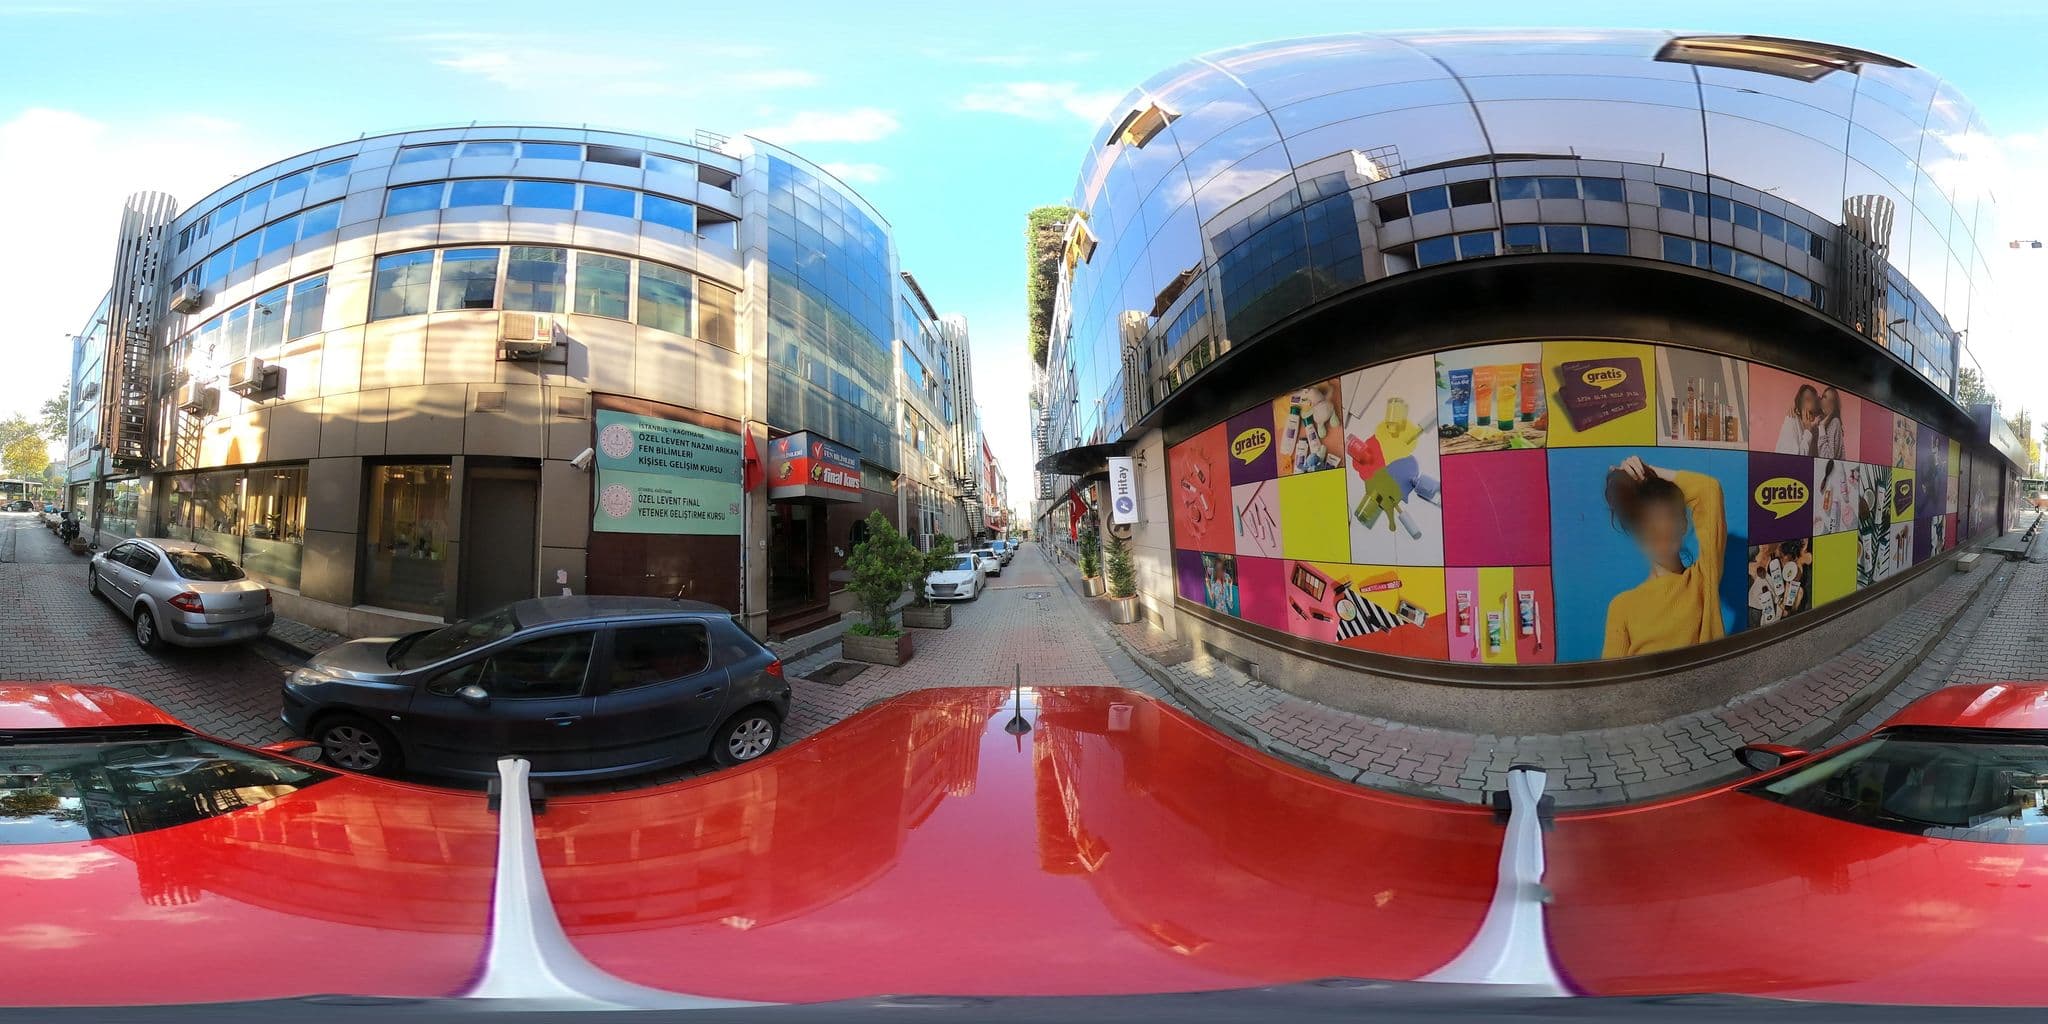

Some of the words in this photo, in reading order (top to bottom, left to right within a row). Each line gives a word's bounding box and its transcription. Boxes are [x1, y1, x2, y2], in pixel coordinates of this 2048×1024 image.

[1587, 369, 1622, 383] gratis
[638, 444, 654, 453] FEN
[656, 446, 693, 458] BİLİMLERİ
[639, 432, 659, 443] ÖZEL
[661, 437, 690, 447] LEVENT
[691, 441, 714, 452] NAZMİ
[715, 446, 739, 456] ARIKAN
[1235, 430, 1266, 456] gratis
[638, 456, 667, 467] KİŞİSEL
[669, 460, 699, 471] GELİŞİM
[700, 465, 723, 474] KURSU
[823, 467, 843, 485] final
[844, 472, 860, 489] kurs
[1118, 466, 1129, 495] Hitay
[638, 494, 655, 504] ÖZEL
[656, 496, 681, 505] LEVENT
[682, 498, 700, 507] FİNAL
[1761, 483, 1804, 505] gratis
[638, 508, 668, 517] YETENEK
[670, 509, 706, 520] GELİŞTİRME
[707, 512, 726, 520] KURSU
